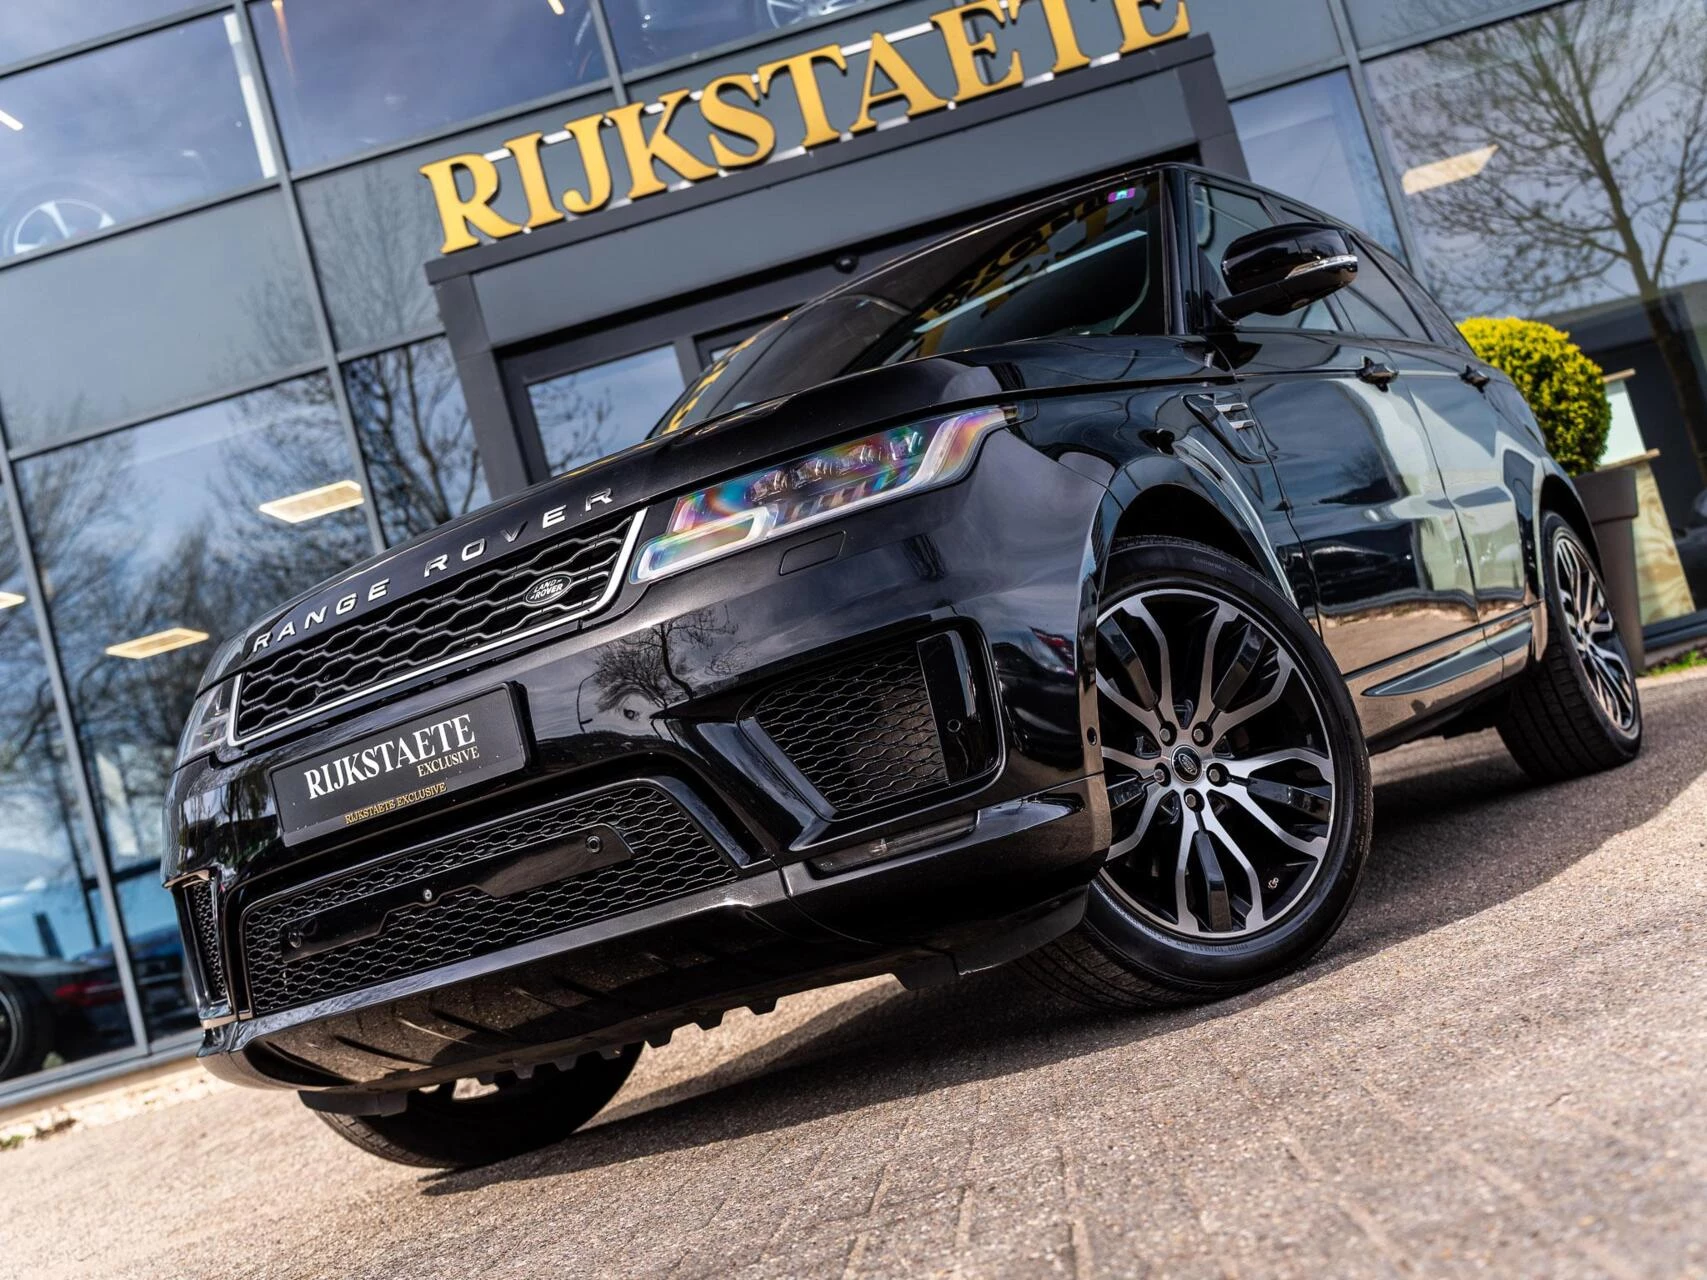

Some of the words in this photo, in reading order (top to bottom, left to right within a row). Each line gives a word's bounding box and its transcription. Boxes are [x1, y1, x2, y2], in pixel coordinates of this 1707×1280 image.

[252, 577, 391, 653] RANGE
[423, 487, 614, 578] ROVER
[534, 583, 564, 600] ROVER
[304, 713, 476, 800] RIJKSTAETE
[416, 745, 480, 778] EXCLUSIVE
[344, 799, 396, 825] RIJKSTAETE
[396, 781, 447, 807] EXCLUSIVE
